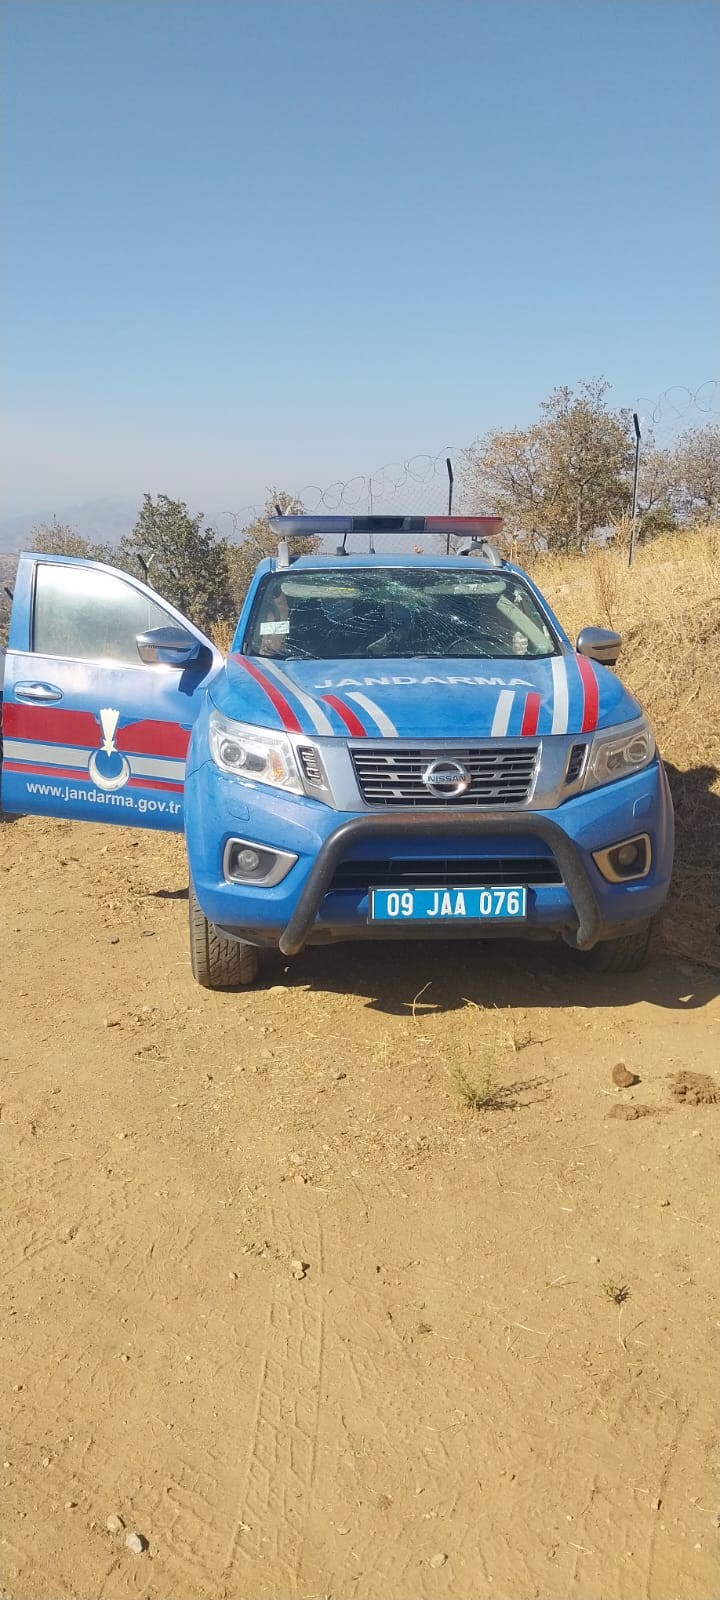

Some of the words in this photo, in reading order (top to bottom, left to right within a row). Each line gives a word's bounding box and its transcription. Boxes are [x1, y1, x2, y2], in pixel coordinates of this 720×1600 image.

[314, 676, 536, 689] JANDARMA
[26, 782, 181, 814] www.jandarma.gov.tr
[387, 892, 414, 917] 09
[426, 892, 467, 916] JAA
[479, 891, 520, 915] 076
